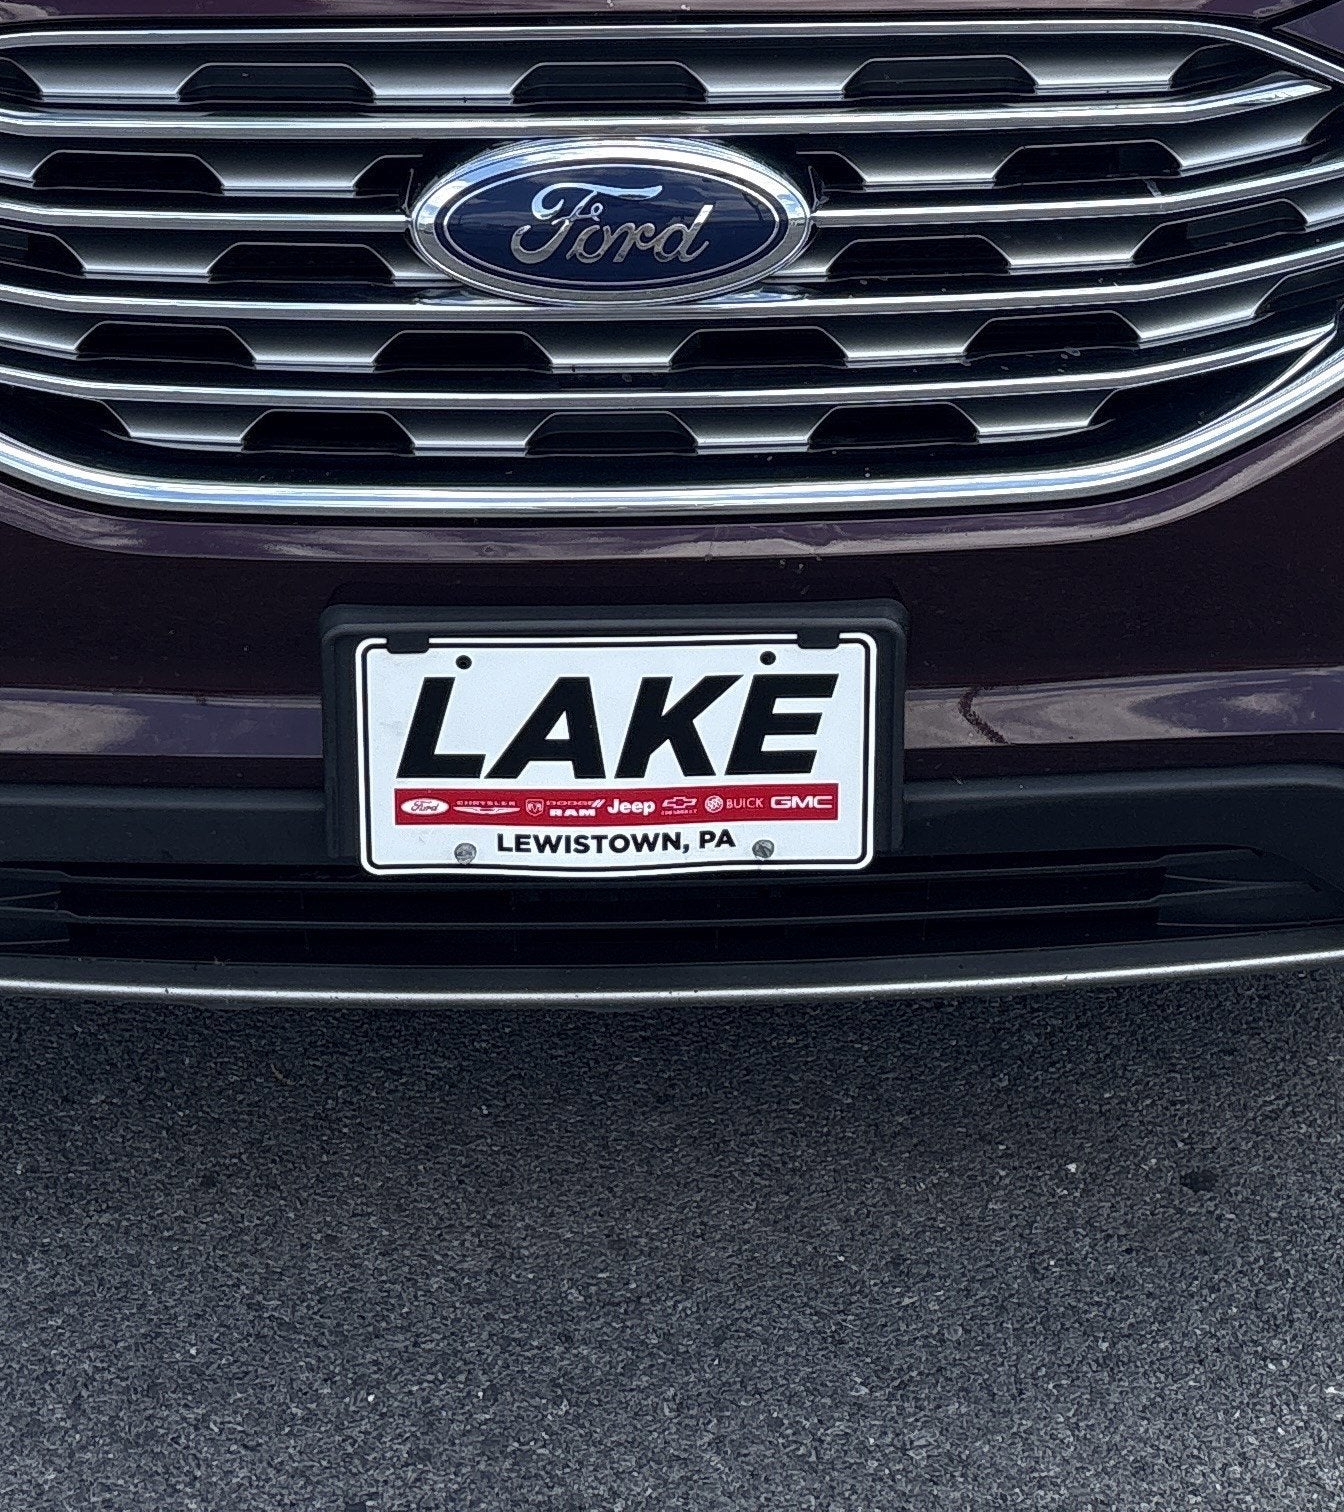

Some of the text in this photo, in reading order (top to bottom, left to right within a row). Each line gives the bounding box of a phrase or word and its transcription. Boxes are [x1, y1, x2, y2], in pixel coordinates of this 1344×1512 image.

[511, 181, 714, 265] Ford
[395, 673, 840, 780] LAKE
[410, 799, 440, 813] Ford
[607, 798, 656, 816] Jeep
[726, 797, 765, 809] BUICK
[770, 795, 833, 809] GMC
[549, 808, 596, 817] RAM
[496, 828, 737, 855] LEWISTOWN, PA
